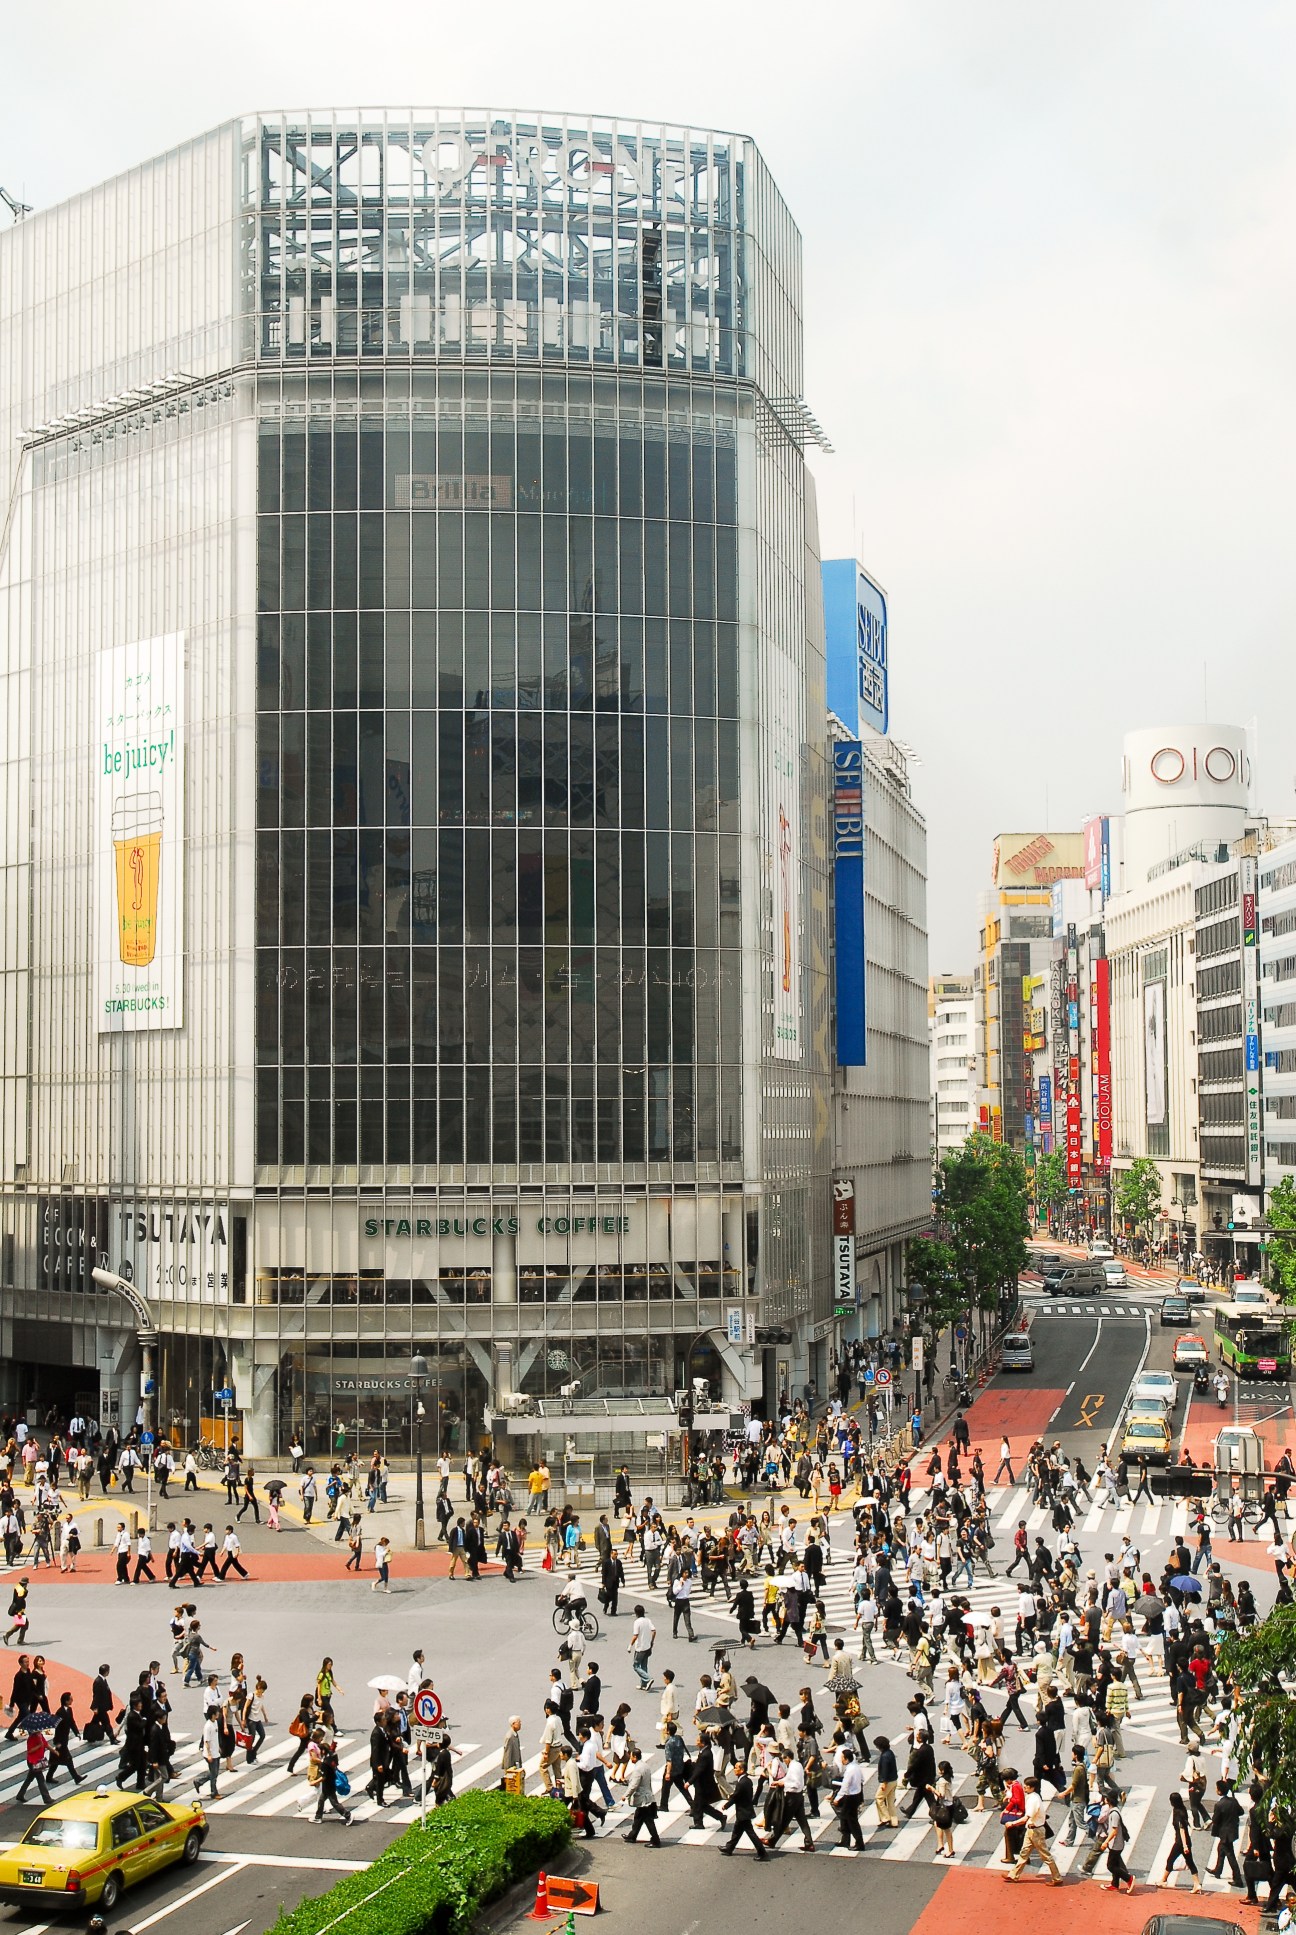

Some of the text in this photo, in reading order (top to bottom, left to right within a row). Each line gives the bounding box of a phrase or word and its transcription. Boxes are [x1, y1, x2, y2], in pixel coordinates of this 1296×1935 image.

[858, 602, 887, 669] SEIBU
[862, 657, 884, 713] 西武
[106, 704, 172, 728] スターバックス
[103, 729, 174, 779] be juicy!
[834, 751, 862, 860] SEIBU
[1004, 835, 1055, 877] TOWER
[105, 996, 170, 1013] STARBUCKS!
[1050, 960, 1061, 1028] KARAOKE
[1069, 1124, 1079, 1187] 東日本銀行
[1249, 1101, 1258, 1162] 住友信託銀行
[119, 1211, 227, 1245] TSUTAYA
[364, 1215, 630, 1237] STARBUCKS COFFEE
[839, 1235, 851, 1299] TSUTAYA
[335, 1380, 401, 1389] STARBUCKS
[415, 1728, 441, 1740] ここから
